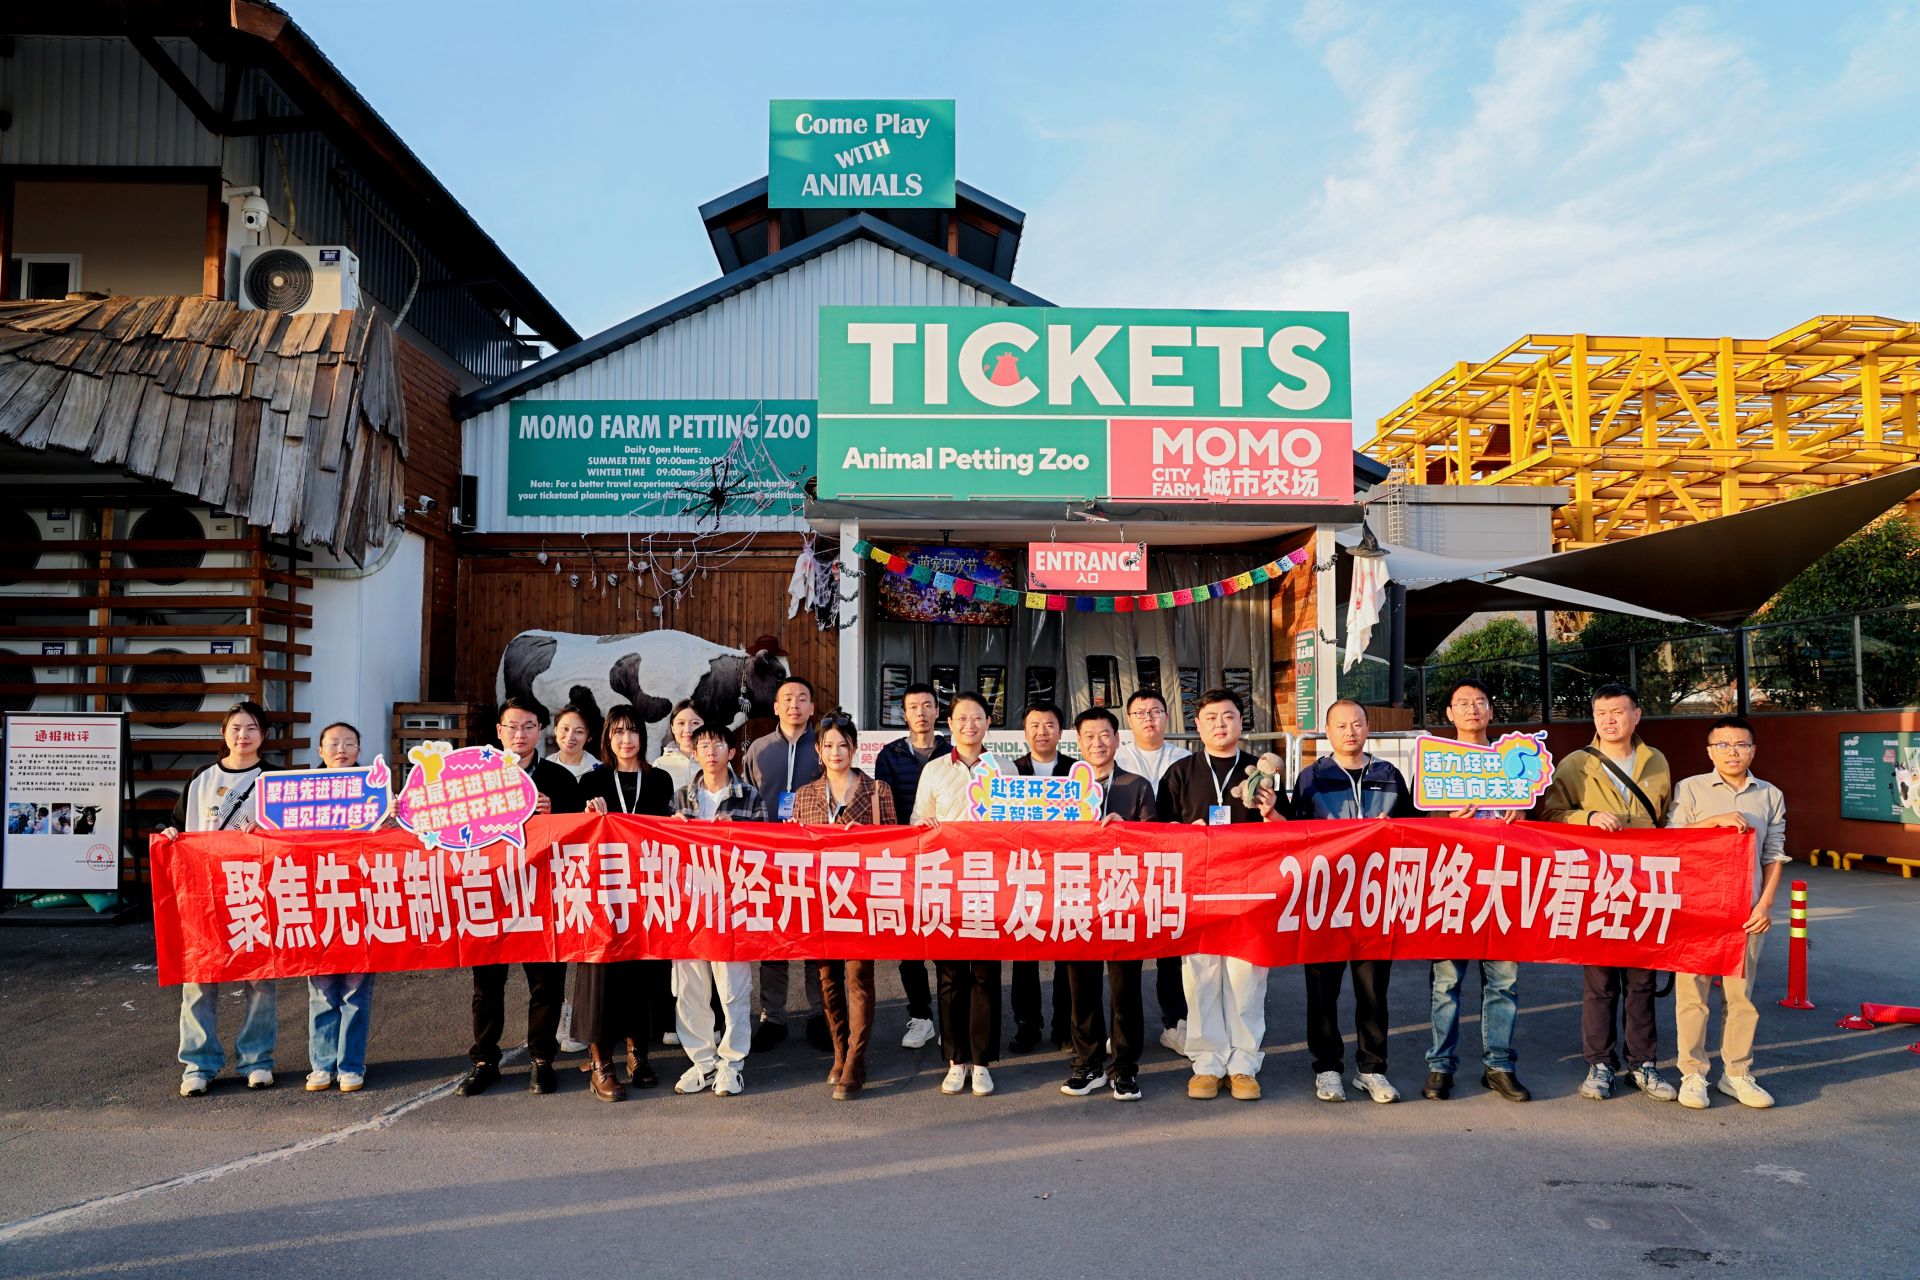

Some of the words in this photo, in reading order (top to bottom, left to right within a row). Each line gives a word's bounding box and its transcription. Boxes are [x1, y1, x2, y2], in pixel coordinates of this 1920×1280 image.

[795, 113, 868, 135] Come
[875, 113, 930, 139] Play
[834, 138, 891, 169] WITH
[801, 173, 923, 197] ANIMALS
[847, 321, 1331, 411] TICKETS
[519, 414, 594, 440] MOMO
[600, 414, 662, 439] FARM
[668, 414, 759, 440] PETTING
[764, 413, 811, 439] ZOO
[624, 445, 646, 456] Daily
[648, 445, 671, 455] Open
[673, 445, 702, 454] Hours:
[1152, 427, 1322, 467] MOMO
[587, 456, 628, 465] SUMMER
[629, 456, 652, 465] TIME
[587, 468, 622, 477] WINTER
[623, 468, 646, 477] TIME
[842, 446, 933, 470] Animal
[938, 447, 1034, 476] Petting
[1038, 447, 1090, 471] Zoo
[530, 479, 554, 488] Note:
[555, 479, 569, 488] For
[578, 479, 605, 488] better
[606, 479, 632, 488] travel
[1151, 467, 1192, 482] CITY
[1203, 466, 1319, 497] 城市农场
[518, 492, 538, 502] your
[539, 491, 579, 500] ticketand
[580, 491, 620, 502] planning
[620, 492, 641, 502] your
[642, 491, 662, 500] visit
[1152, 482, 1201, 497] FARM
[1075, 572, 1099, 584] 入口
[34, 729, 90, 743] 通报批评
[1423, 752, 1502, 773] 活力经开
[265, 777, 364, 803] 聚焦先进制造
[407, 766, 522, 808] 发展先进制造
[990, 778, 1081, 800] 赴经开之约
[1423, 776, 1530, 800] 智造向未来
[282, 805, 380, 829] 遇见活力经开
[411, 789, 527, 833] 绽放经开光彩
[990, 805, 1081, 821] 寻智造之光
